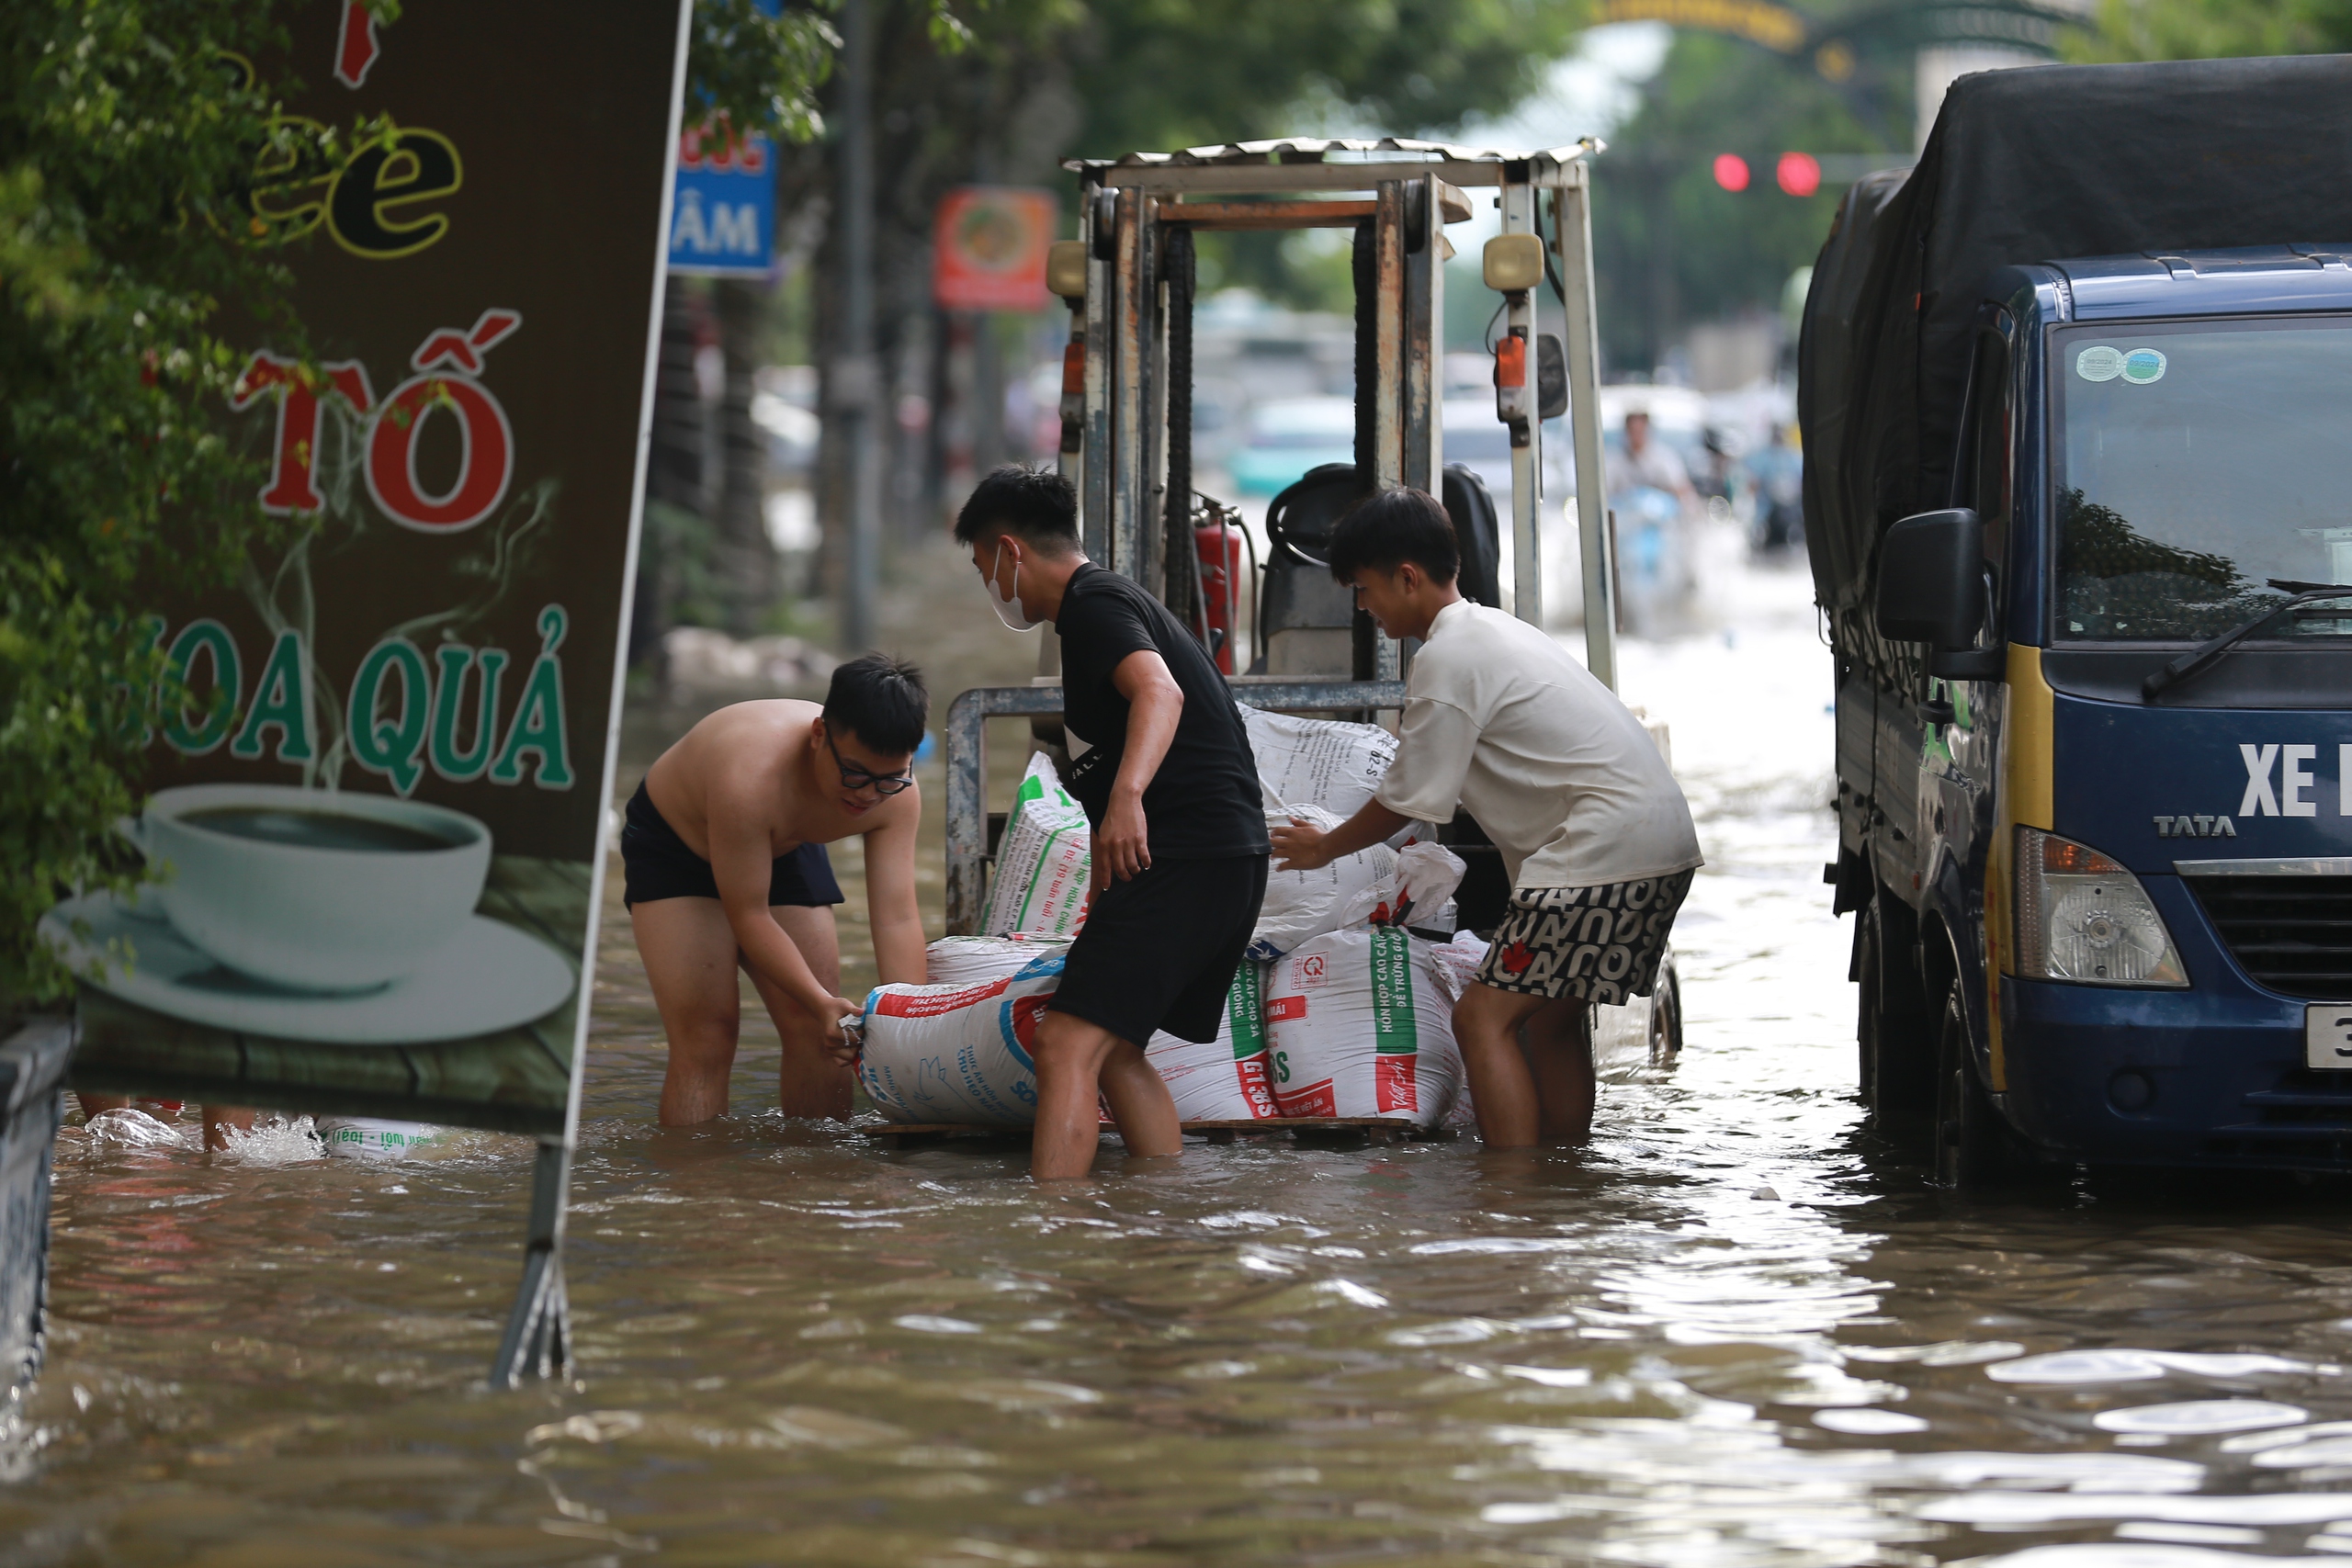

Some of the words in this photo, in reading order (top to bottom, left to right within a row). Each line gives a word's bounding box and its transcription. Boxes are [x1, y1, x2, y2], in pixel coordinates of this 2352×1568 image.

[2129, 359, 2159, 367] 09/2024
[229, 309, 522, 533] TỐ
[346, 603, 575, 798] QUẢ
[2238, 743, 2316, 817] XE
[2153, 815, 2237, 837] TATA
[1057, 863, 1069, 878] (19
[1074, 867, 1089, 886] HỢP
[1048, 879, 1063, 898] tuần
[1062, 886, 1080, 909] HOÀN
[1041, 900, 1055, 918] tuổi
[1054, 910, 1070, 934] CHỈN
[1377, 959, 1389, 981] CAO
[1390, 956, 1406, 993] TRỨNG
[1378, 984, 1393, 1006] HỢP
[1248, 1000, 1258, 1021] CHO
[1376, 1009, 1393, 1033] HỖN
[1242, 1061, 1279, 1119] G138S
[332, 1129, 363, 1145] loại)
[380, 1132, 405, 1151] tuổi
